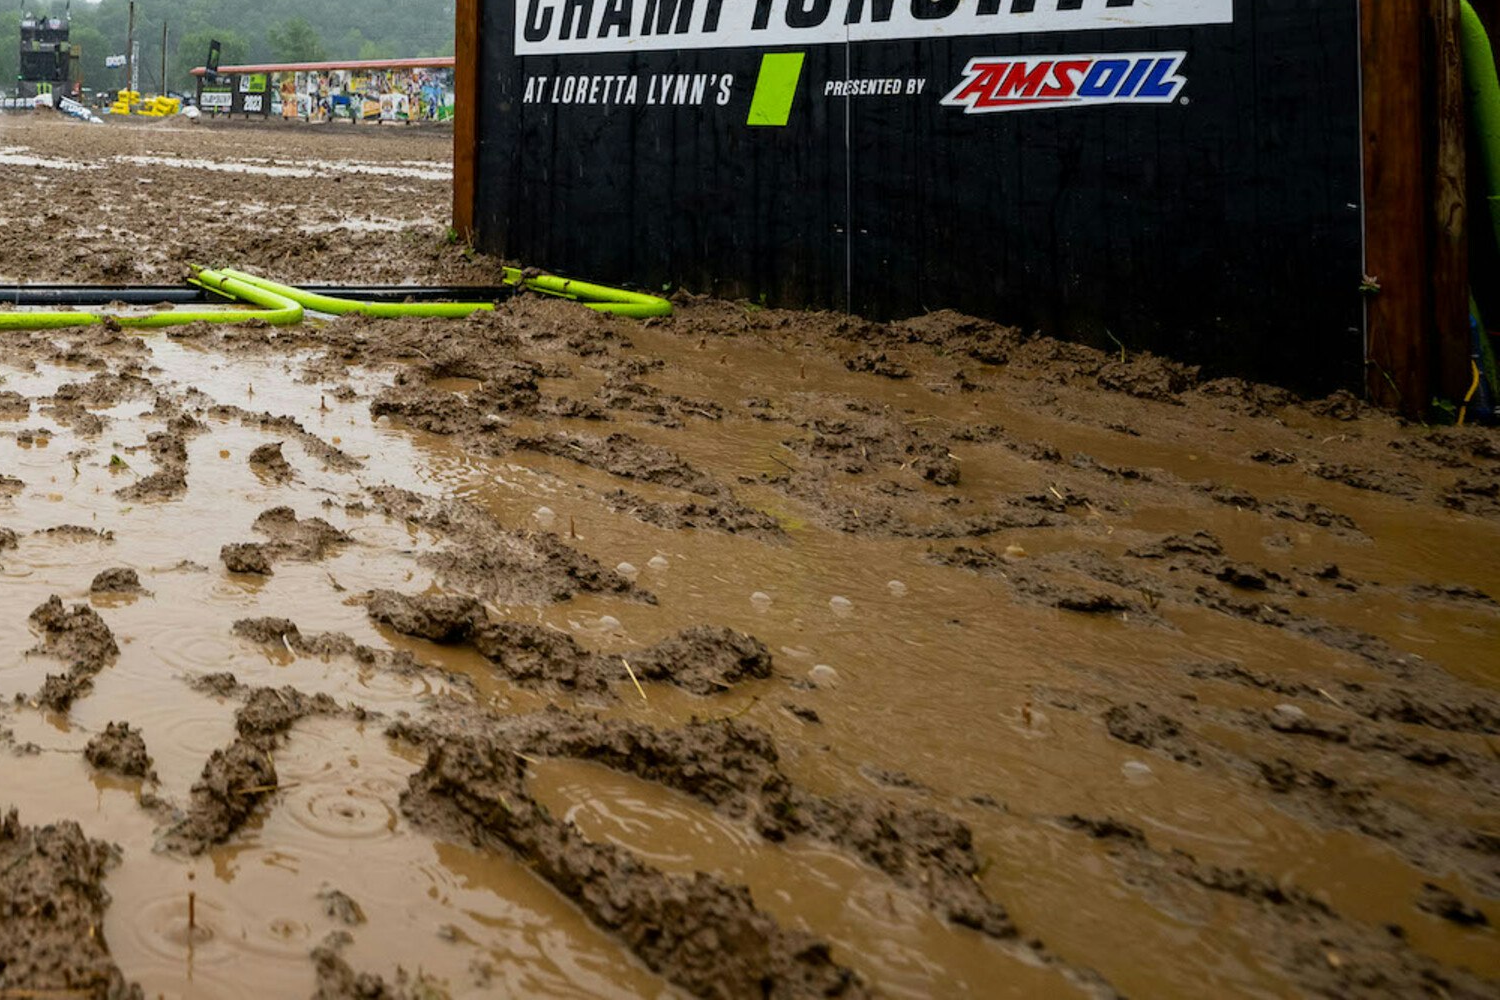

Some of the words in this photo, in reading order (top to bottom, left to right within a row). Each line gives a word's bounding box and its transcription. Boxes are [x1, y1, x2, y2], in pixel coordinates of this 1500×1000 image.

[523, 77, 547, 104] AT
[551, 75, 638, 105] LORETTA
[824, 79, 902, 96] PRESENTED
[905, 78, 926, 95] BY
[953, 58, 1177, 109] AMSOIL
